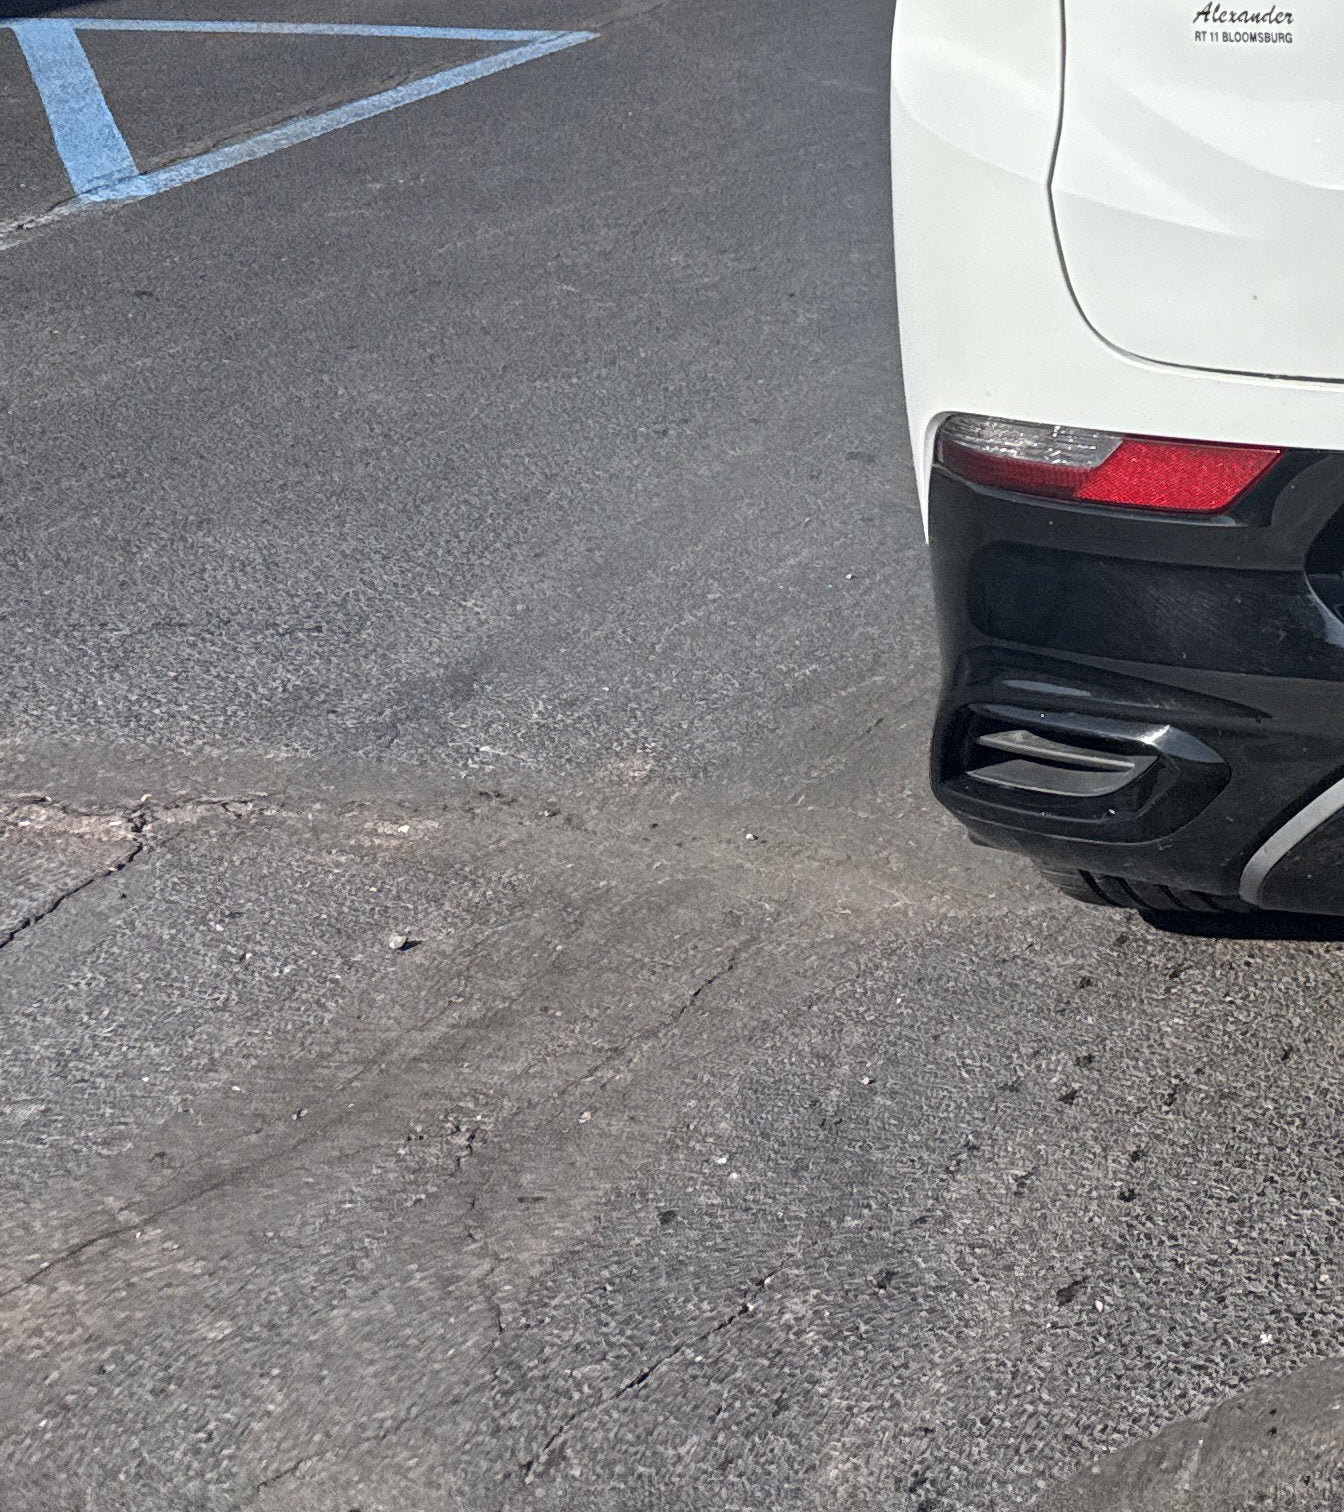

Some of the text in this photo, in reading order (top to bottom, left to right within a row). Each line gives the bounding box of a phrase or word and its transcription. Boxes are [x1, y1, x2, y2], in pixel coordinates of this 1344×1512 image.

[1193, 1, 1295, 25] Alexander
[1194, 30, 1293, 44] RT 11 BLOOMSBURG
